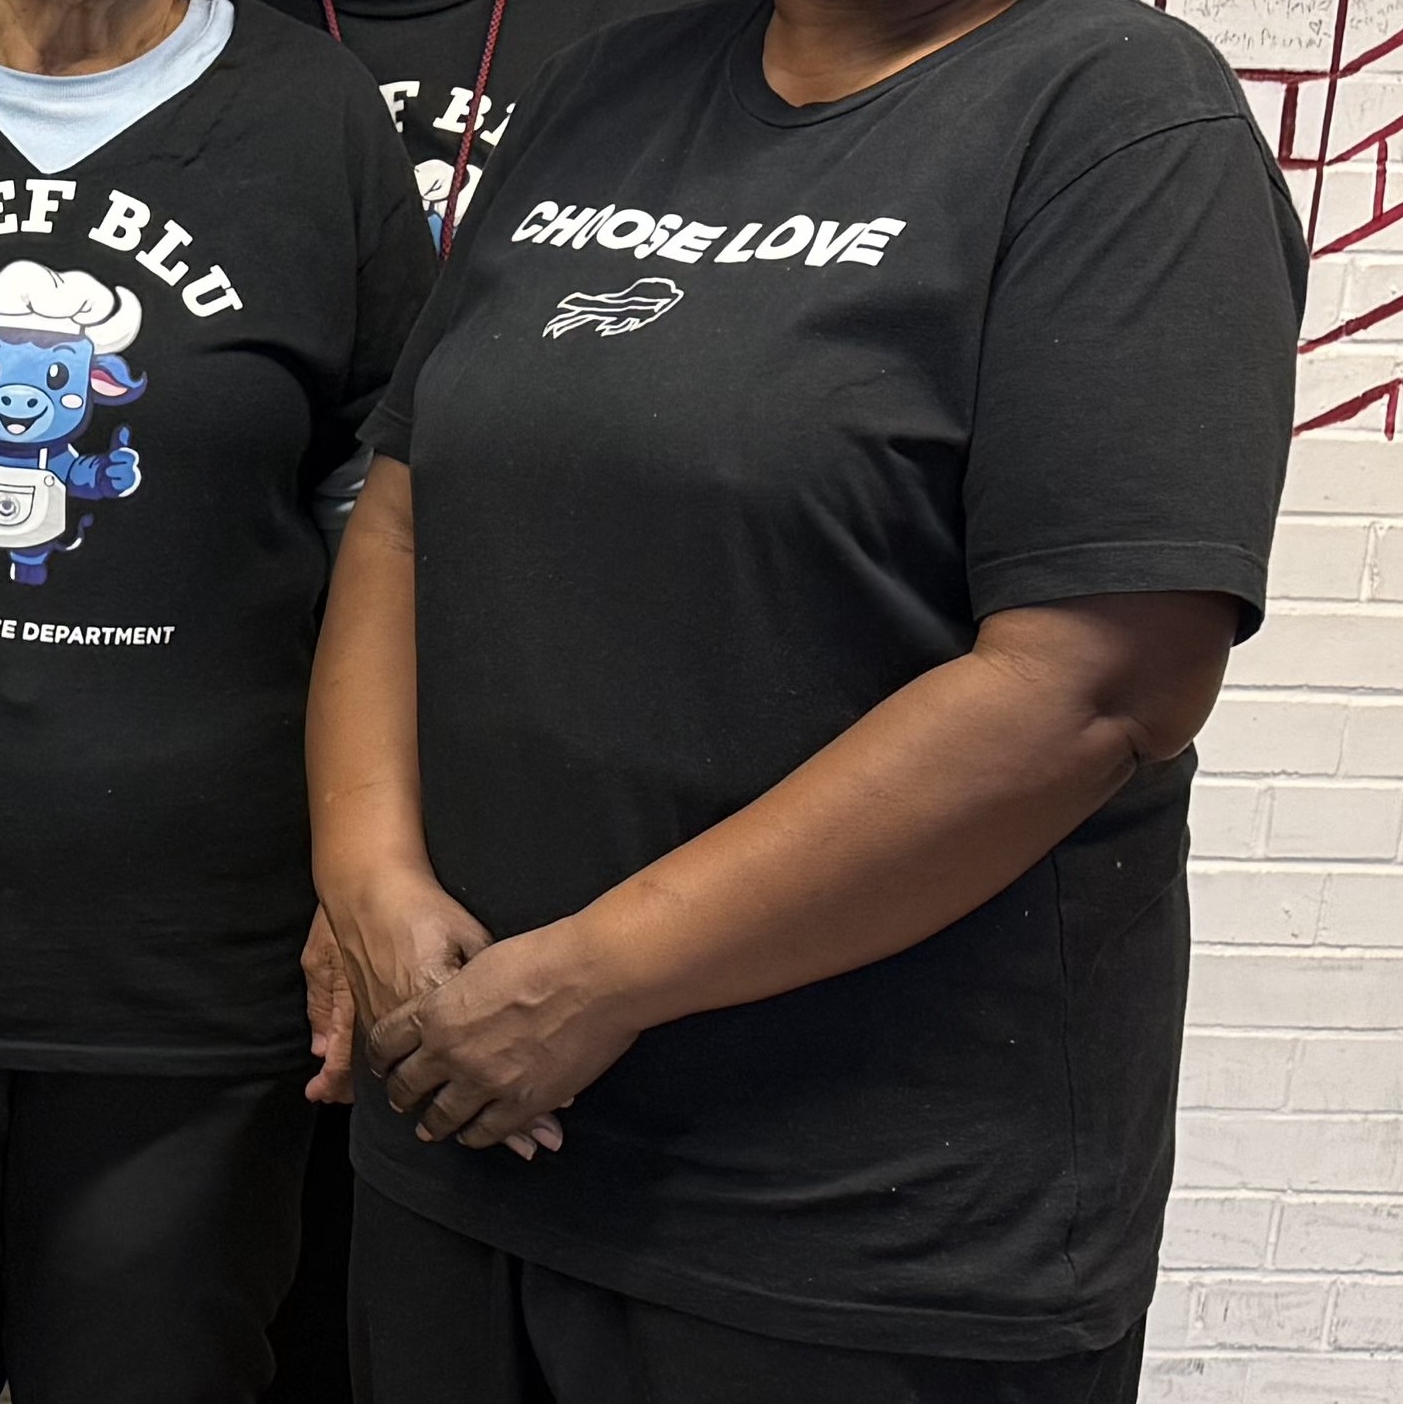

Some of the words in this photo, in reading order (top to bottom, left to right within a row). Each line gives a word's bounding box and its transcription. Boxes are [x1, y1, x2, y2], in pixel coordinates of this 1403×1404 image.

[87, 188, 244, 318] BLU
[511, 200, 728, 265] CHOOSE
[713, 214, 908, 268] LOVE
[21, 621, 176, 646] DEPARTMENT
